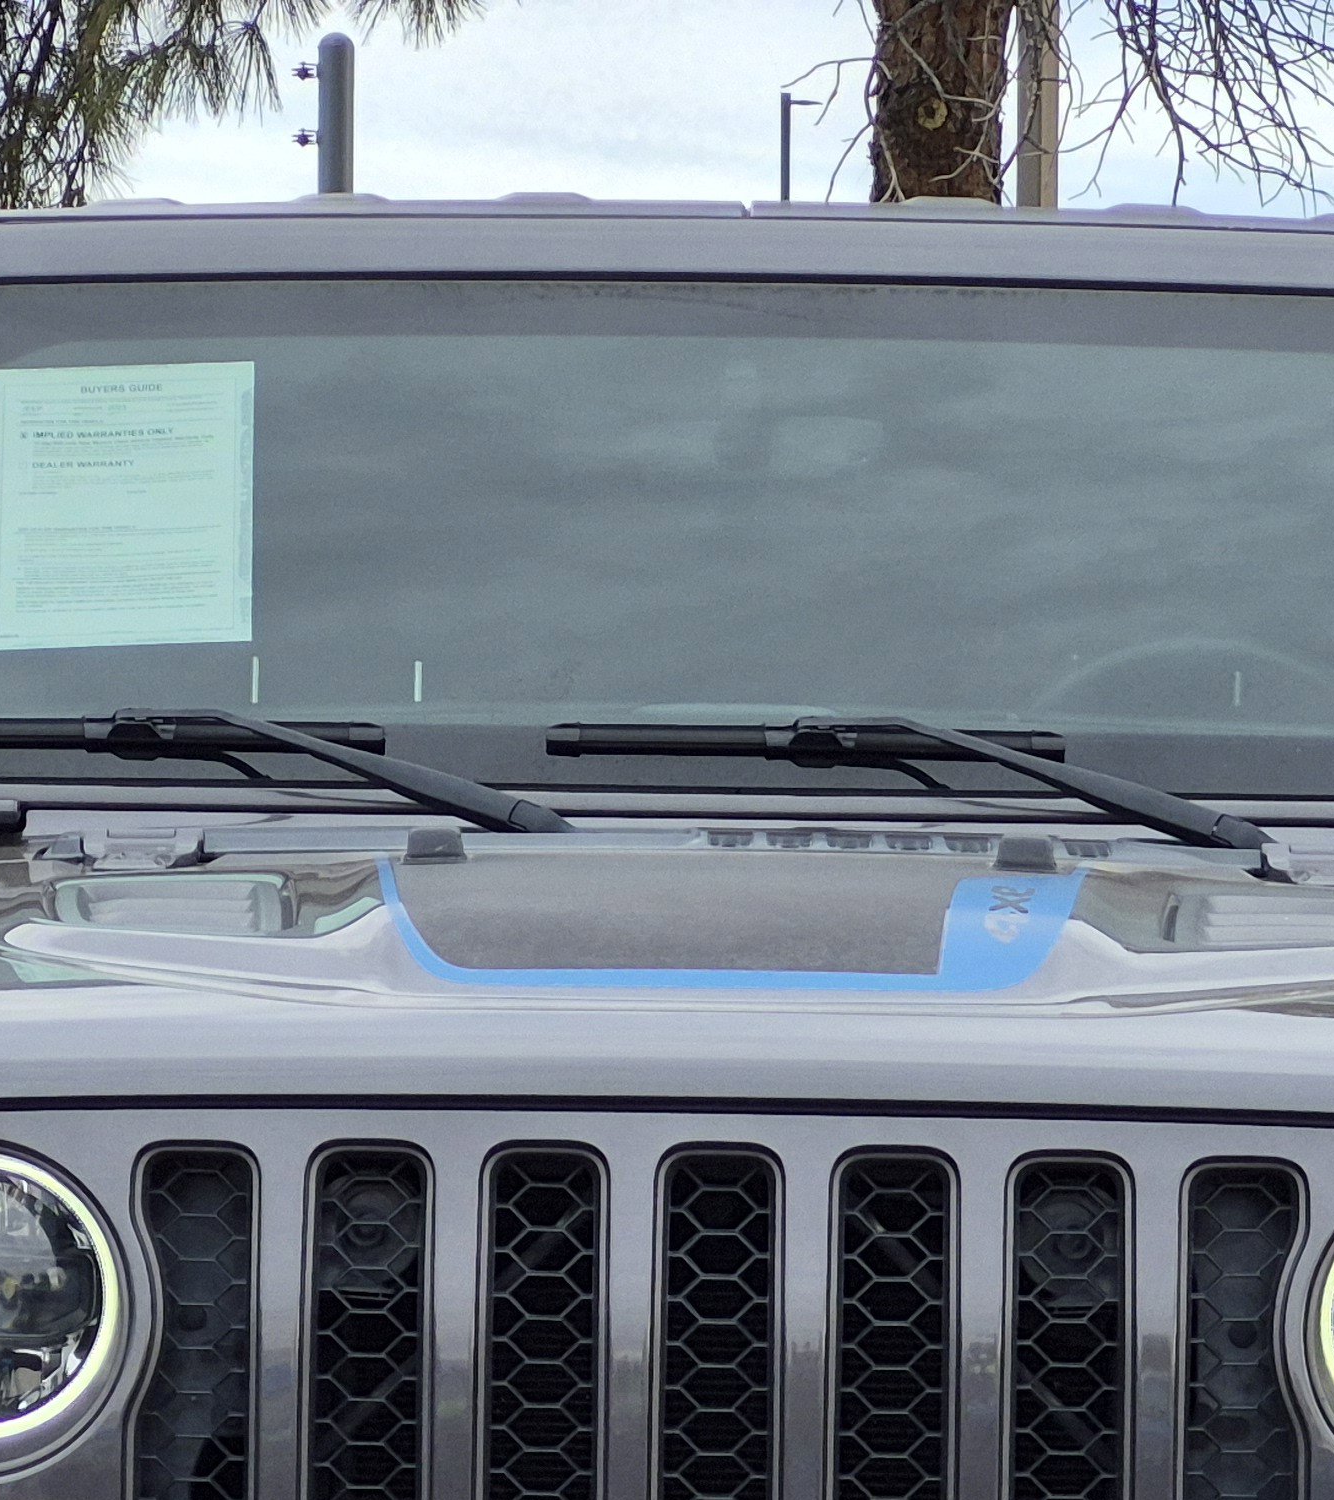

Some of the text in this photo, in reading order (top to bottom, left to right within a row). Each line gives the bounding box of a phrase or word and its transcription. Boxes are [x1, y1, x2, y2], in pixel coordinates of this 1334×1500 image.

[80, 383, 163, 394] BUYERS GUIDE
[32, 427, 174, 439] IMPLIED WARRANTIES ONLY
[32, 459, 134, 469] DEALER WARRANTY
